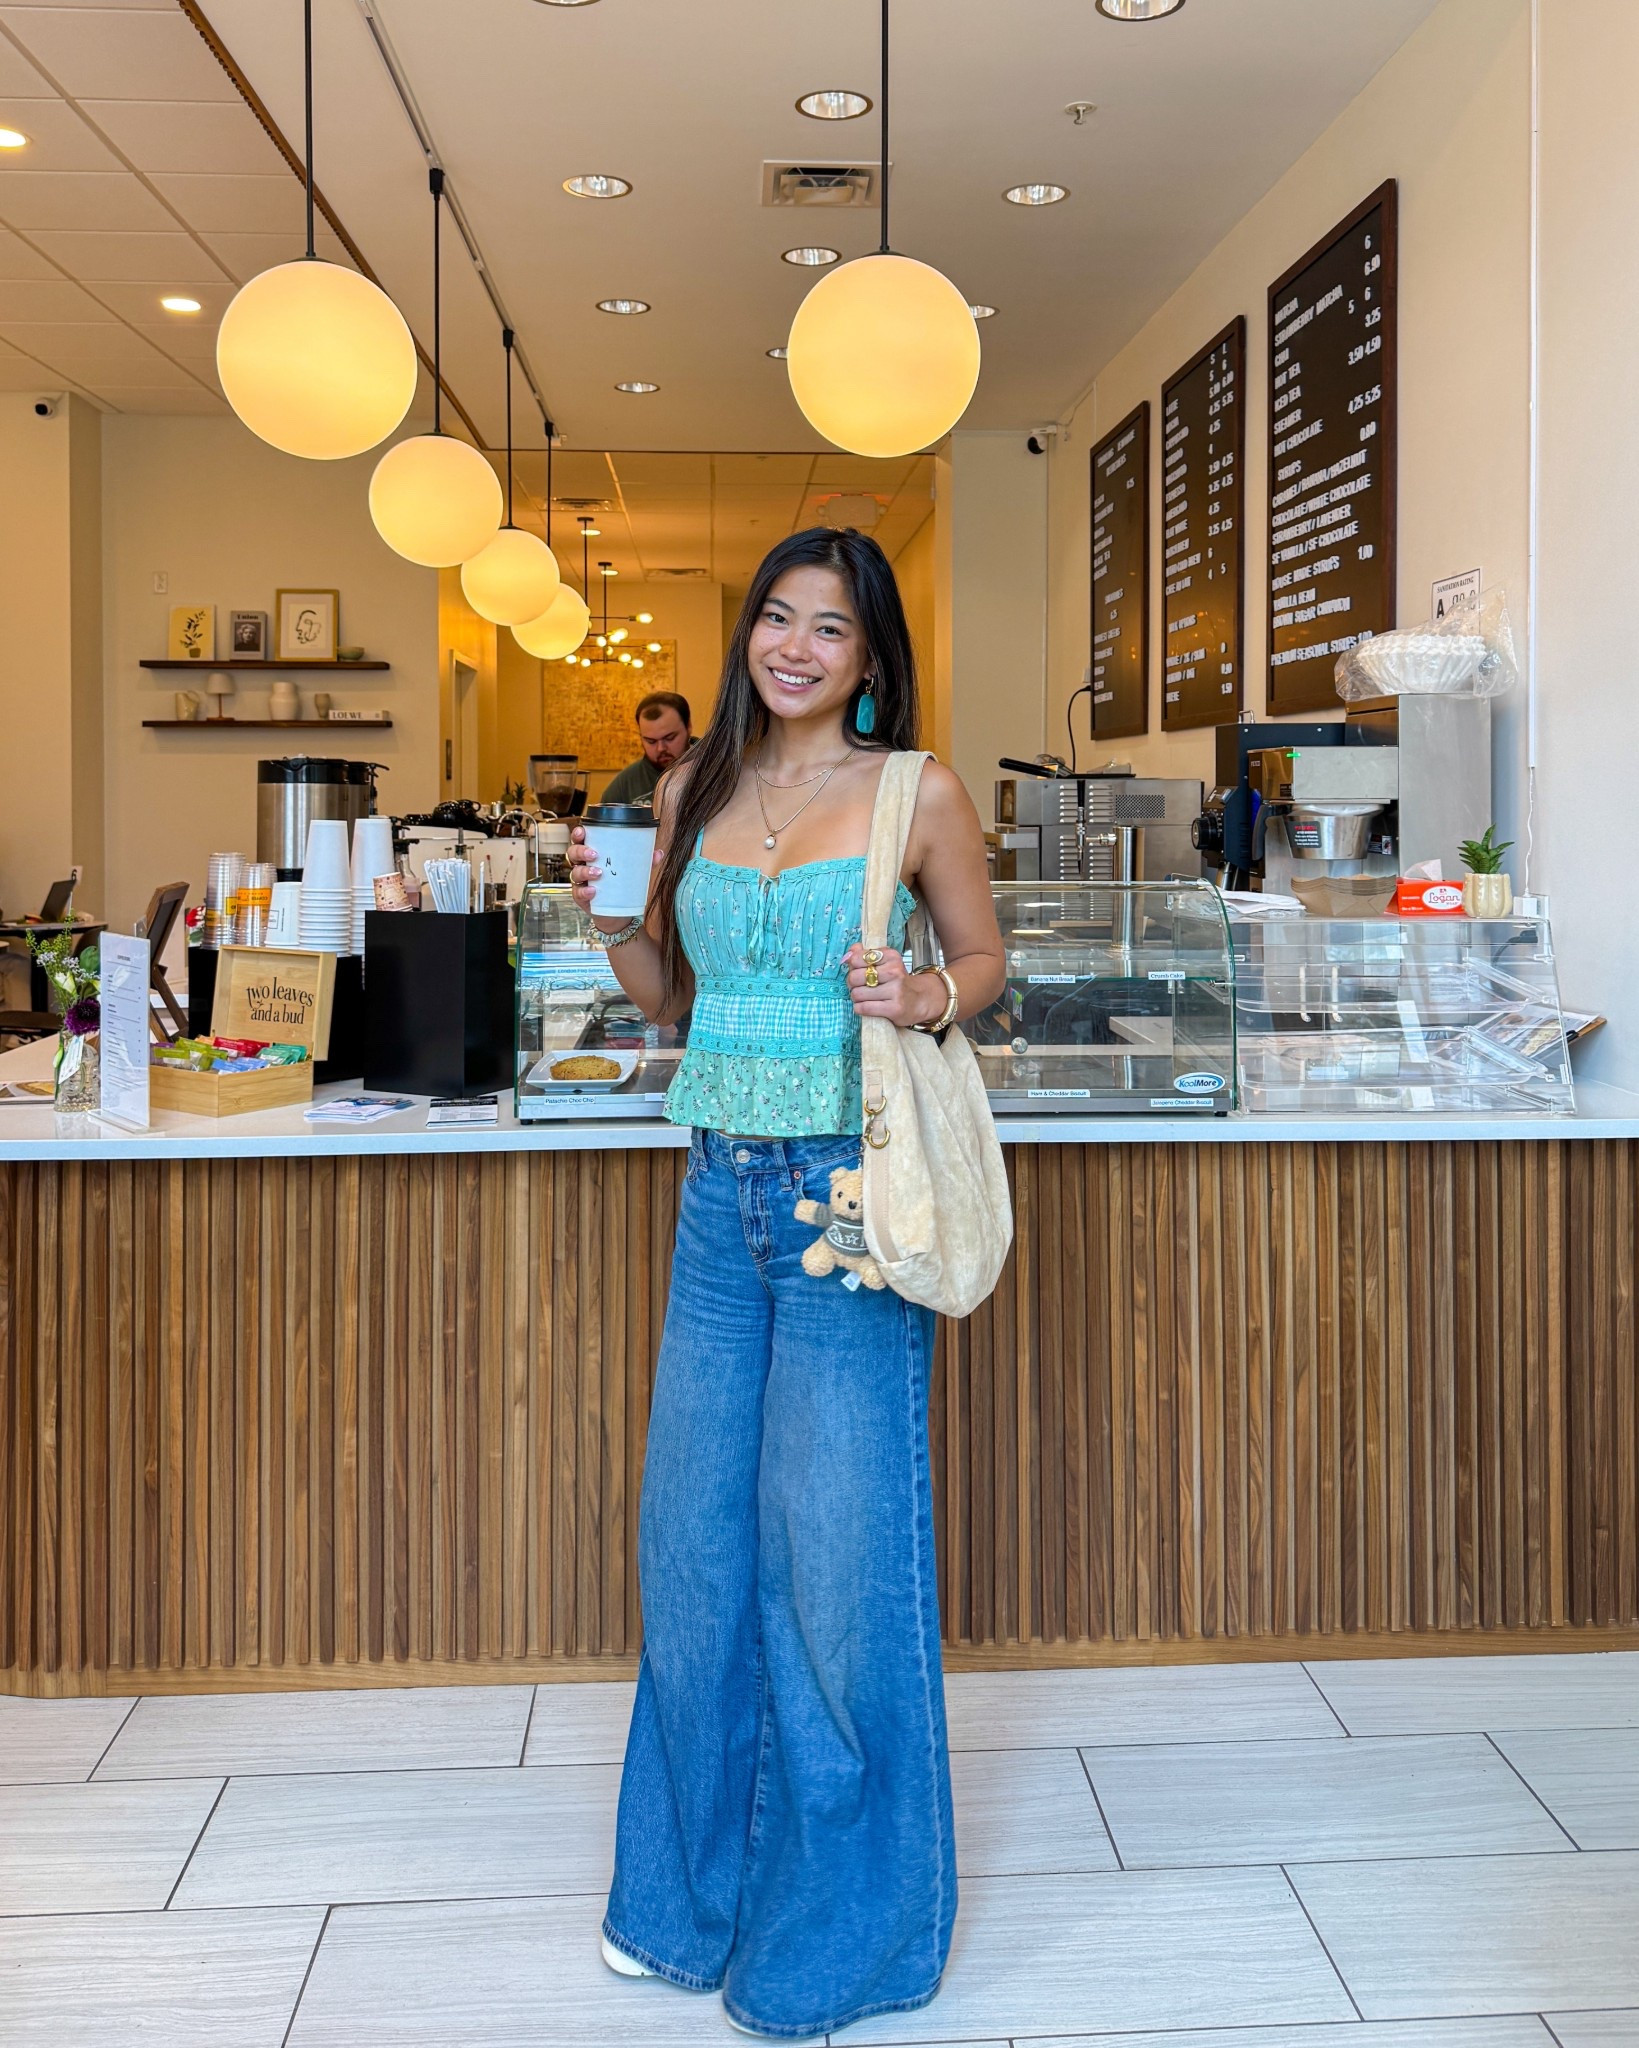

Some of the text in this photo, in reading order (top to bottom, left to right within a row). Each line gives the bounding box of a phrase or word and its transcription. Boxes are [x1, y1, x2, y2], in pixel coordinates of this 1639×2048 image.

[1364, 235, 1371, 249] 6
[1348, 299, 1355, 314] 5
[1364, 287, 1371, 301] 6
[1288, 362, 1301, 379] TEA
[1288, 385, 1301, 403] TEA
[1286, 419, 1323, 450] CHOCOLATE
[1329, 473, 1371, 503] CHOCOLATE
[1318, 521, 1358, 547] CHOCOLATE
[1221, 563, 1226, 574] 5
[1436, 598, 1445, 619] A
[1428, 892, 1460, 904] Logan
[246, 977, 315, 1009] two leaves
[251, 1003, 305, 1024] and a bud
[1178, 1079, 1216, 1088] KoolMore
